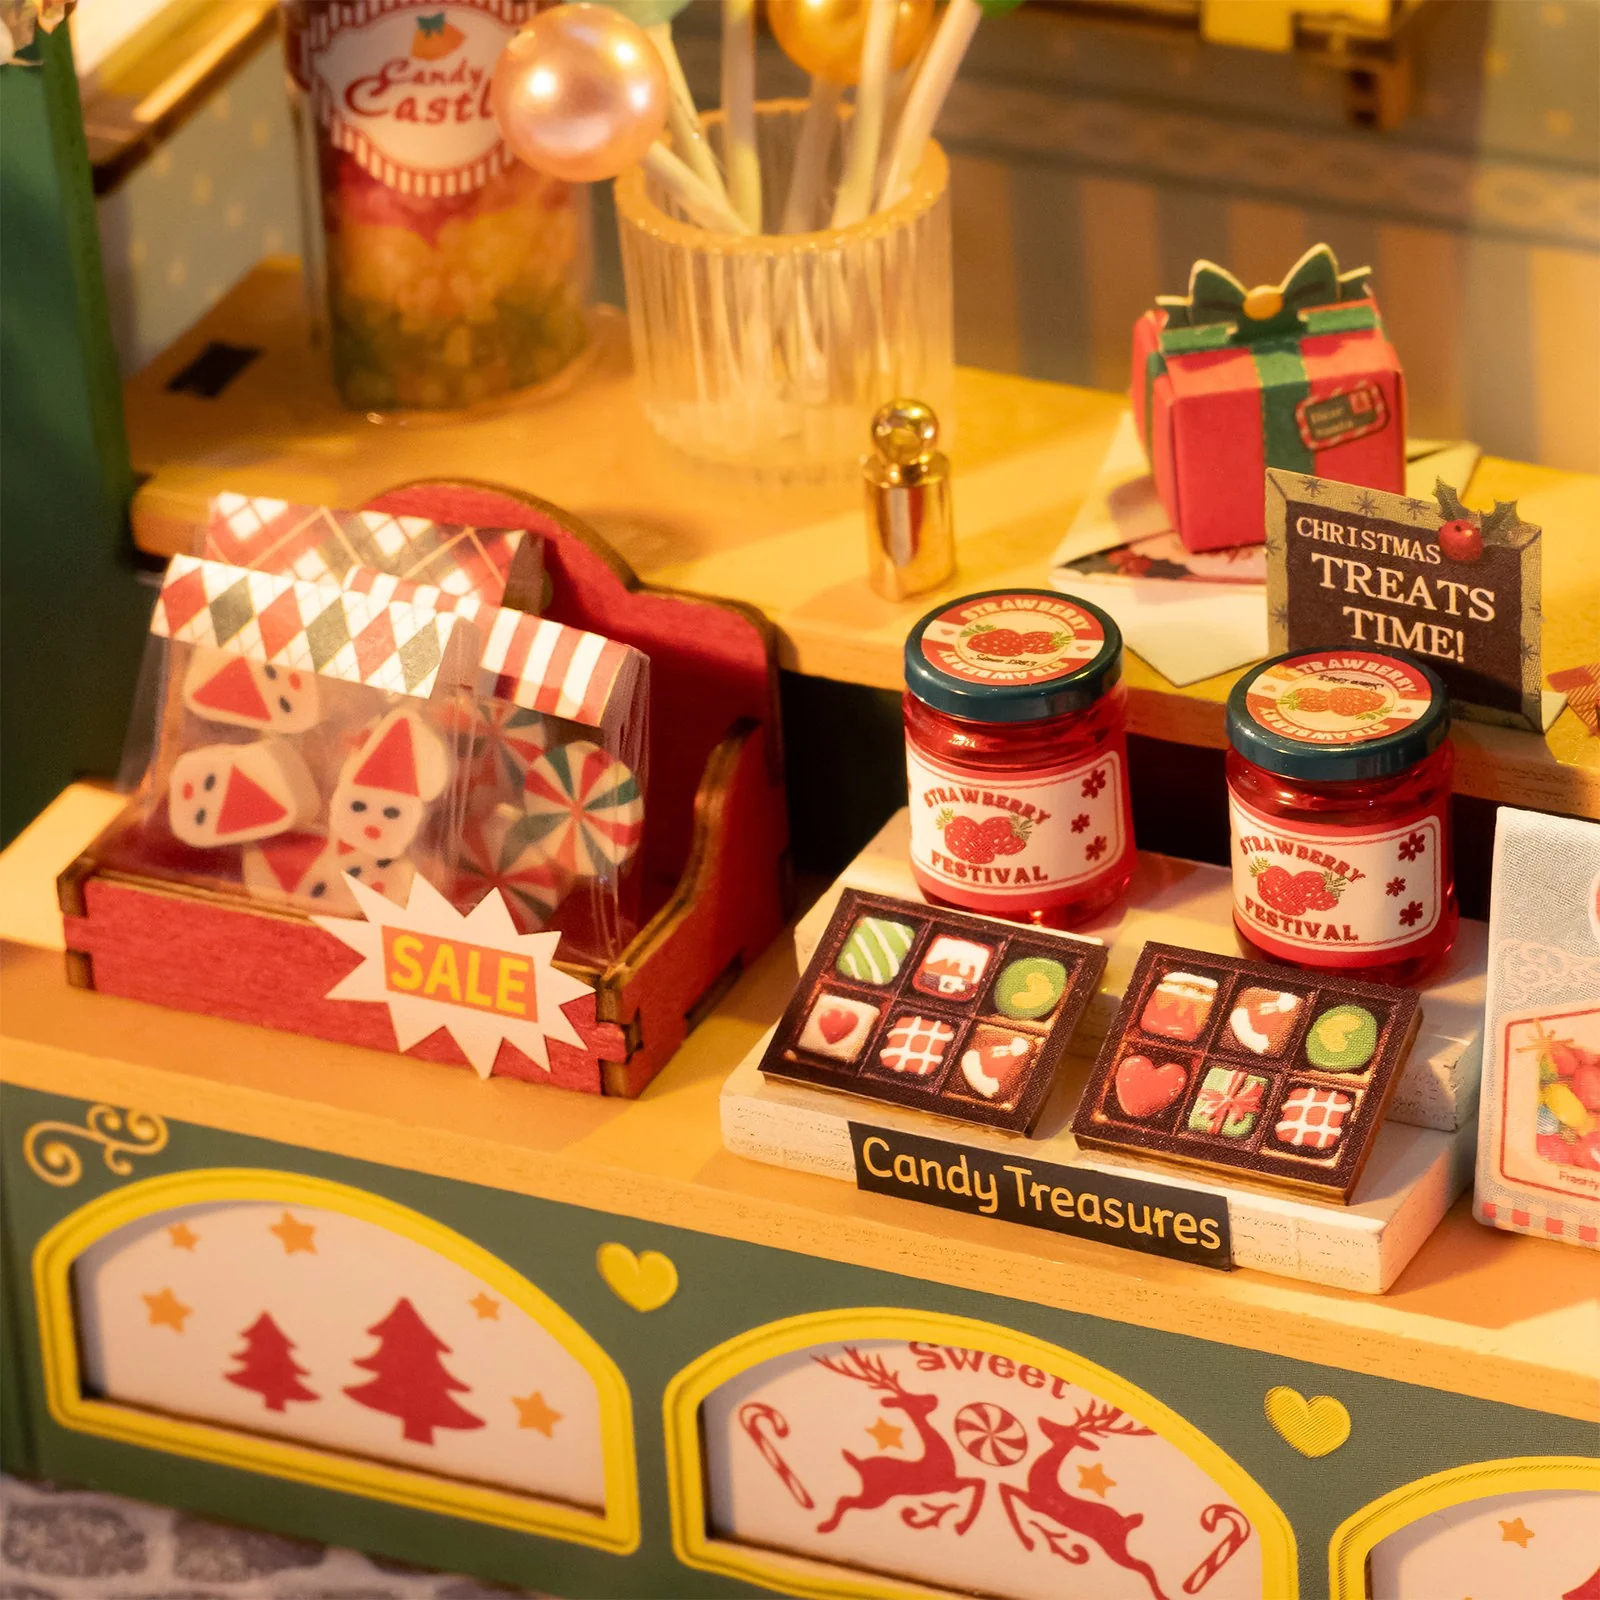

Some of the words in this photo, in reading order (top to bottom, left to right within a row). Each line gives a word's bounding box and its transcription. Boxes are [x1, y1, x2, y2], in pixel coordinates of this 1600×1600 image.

[379, 58, 485, 90] Candy
[345, 75, 493, 125] Castl
[1295, 516, 1442, 565] CHRISTMAS
[1311, 552, 1496, 622] TREATS
[959, 598, 1092, 631] STRAWBERRY
[1342, 606, 1465, 663] TIME!
[1293, 658, 1417, 693] STRAWBERRY
[924, 787, 1052, 825] STRAWBERRY
[931, 849, 1049, 884] FESTIVAL
[1240, 834, 1366, 884] STRAWBERRY
[1245, 895, 1359, 941] FESTIVAL
[391, 934, 530, 1015] SALE
[862, 1136, 999, 1214] Candy
[1003, 1164, 1222, 1250] Treasures
[908, 1341, 1071, 1400] Sweet
